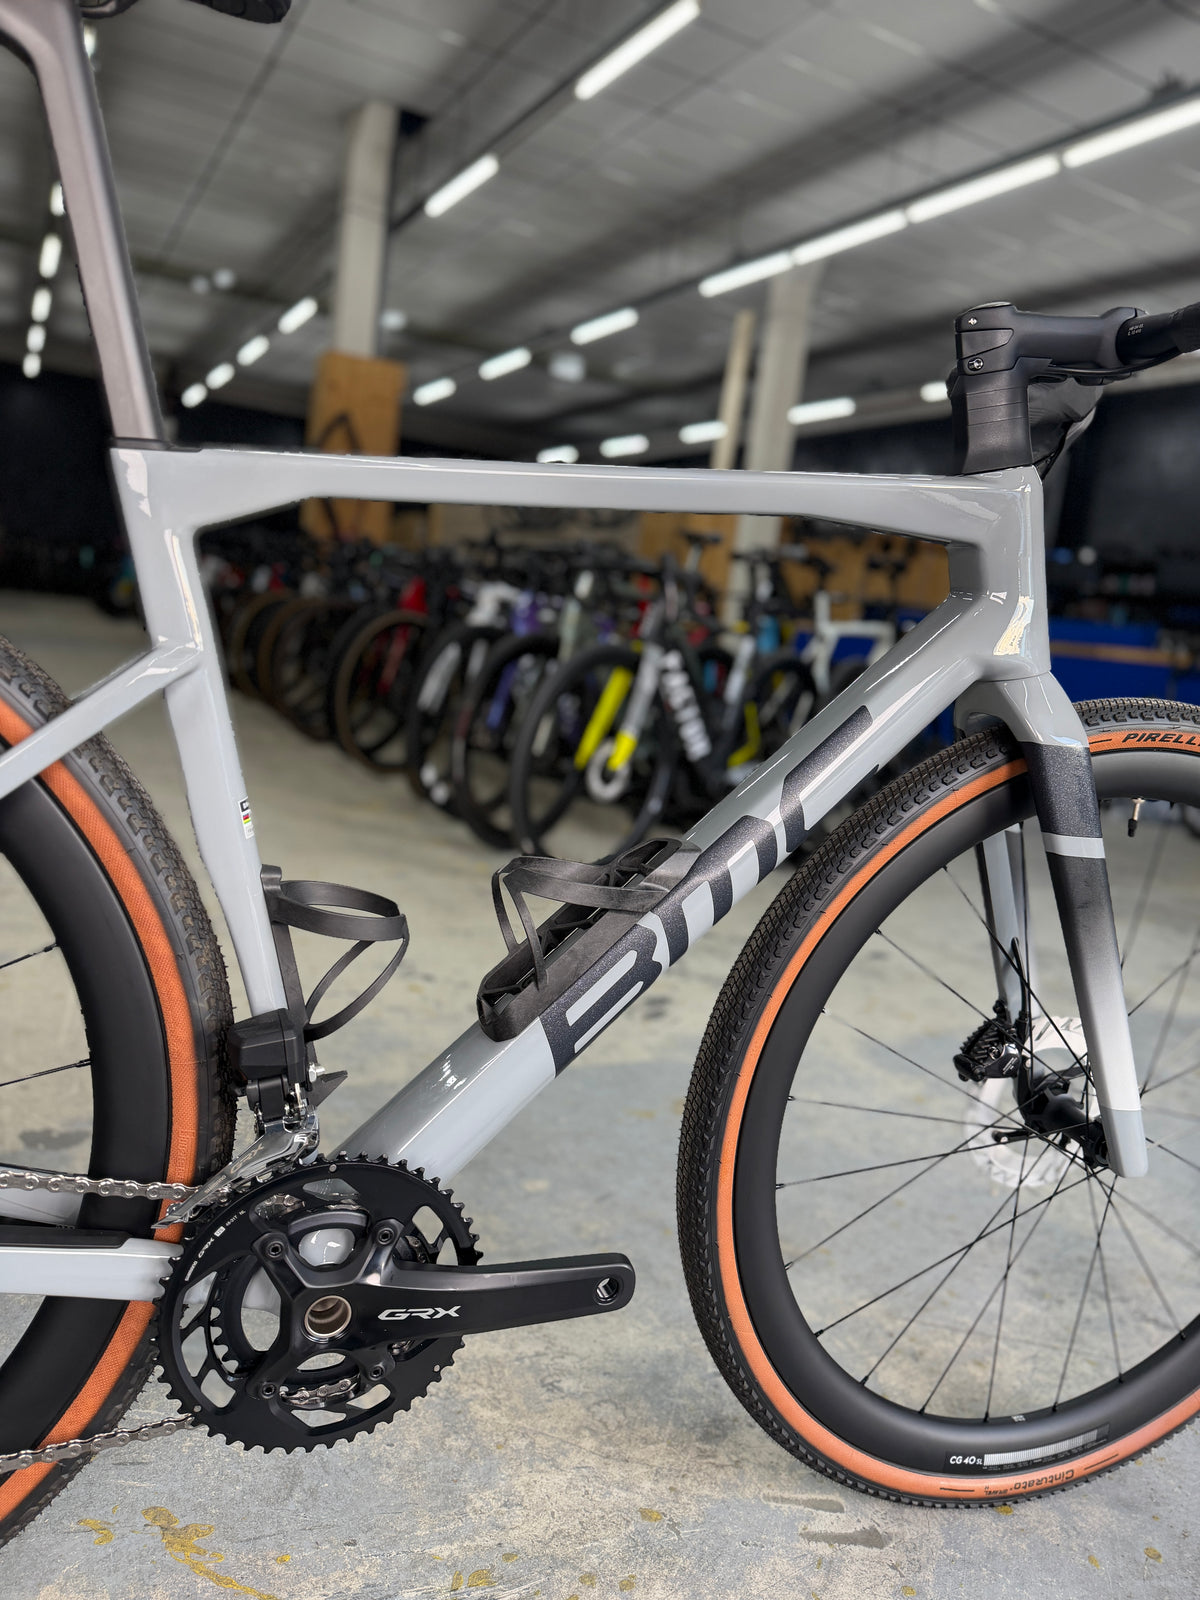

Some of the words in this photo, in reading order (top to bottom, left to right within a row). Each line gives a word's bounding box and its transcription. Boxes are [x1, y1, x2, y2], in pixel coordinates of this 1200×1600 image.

[1121, 732, 1200, 747] PIRELL
[230, 1143, 265, 1174] GRX
[377, 1305, 462, 1321] GRX
[949, 1455, 963, 1465] CG
[963, 1455, 976, 1465] 40
